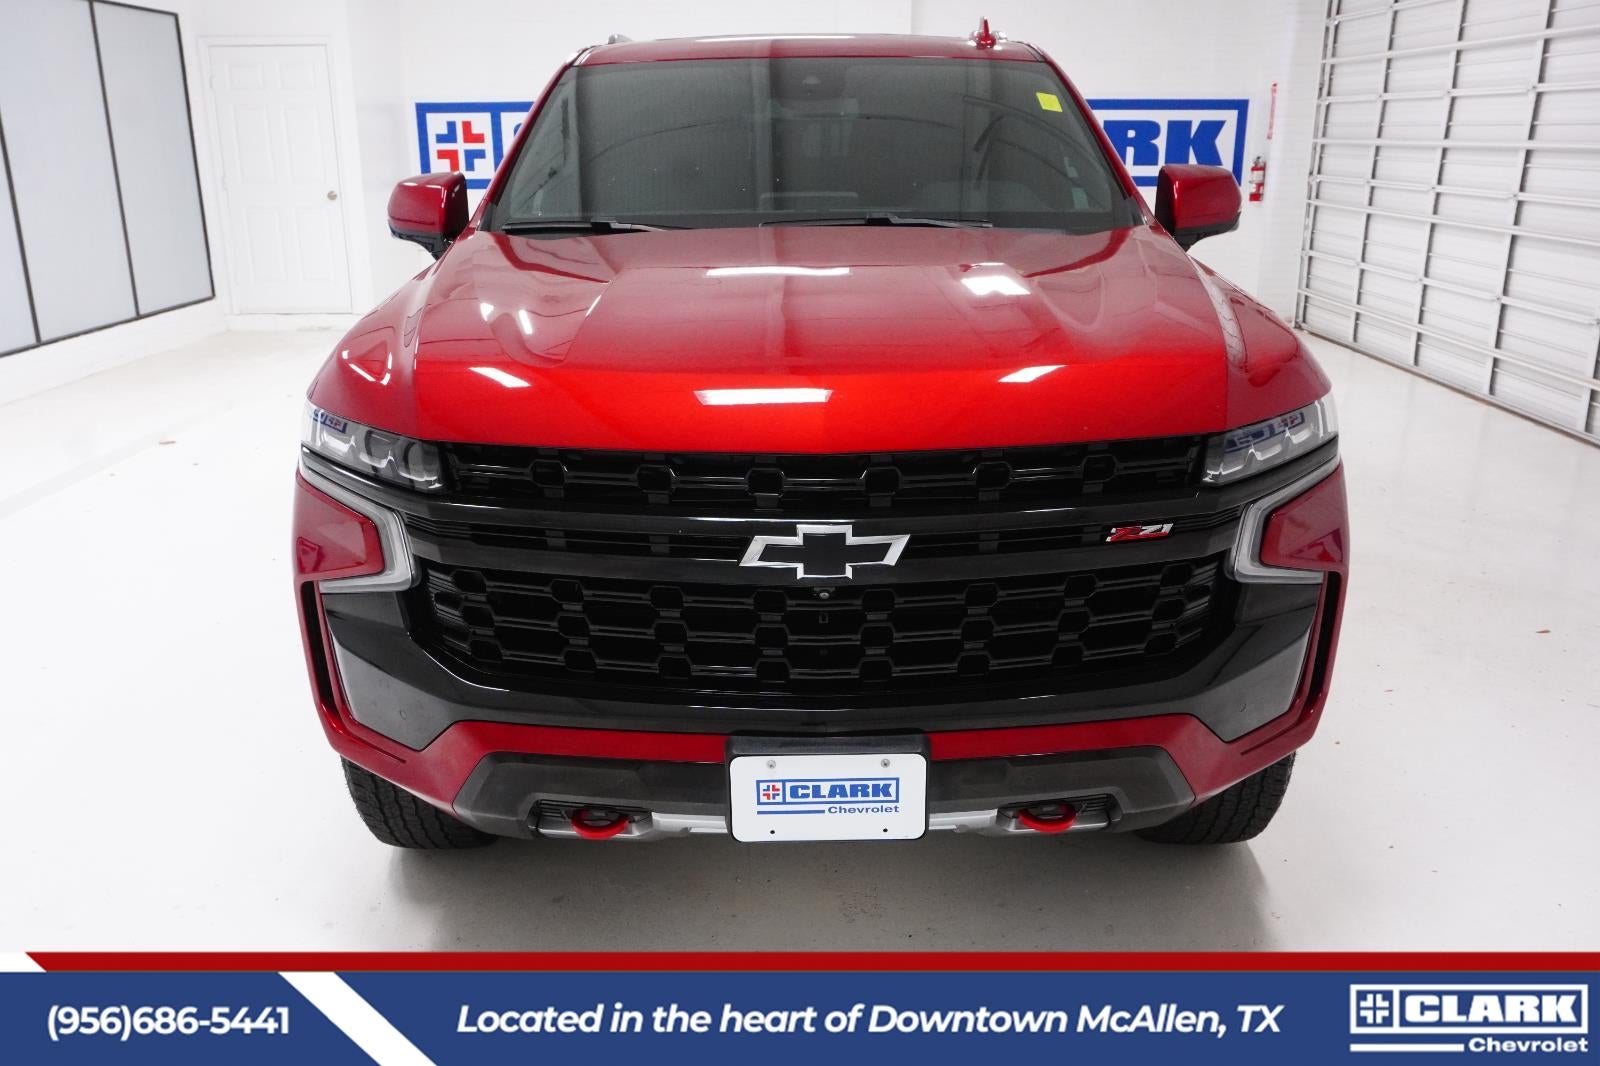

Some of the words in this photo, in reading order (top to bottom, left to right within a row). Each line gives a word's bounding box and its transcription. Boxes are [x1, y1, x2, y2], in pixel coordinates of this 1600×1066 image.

[1106, 523, 1174, 542] Z71
[789, 783, 893, 799] CLARK
[827, 805, 900, 814] Chevrolet
